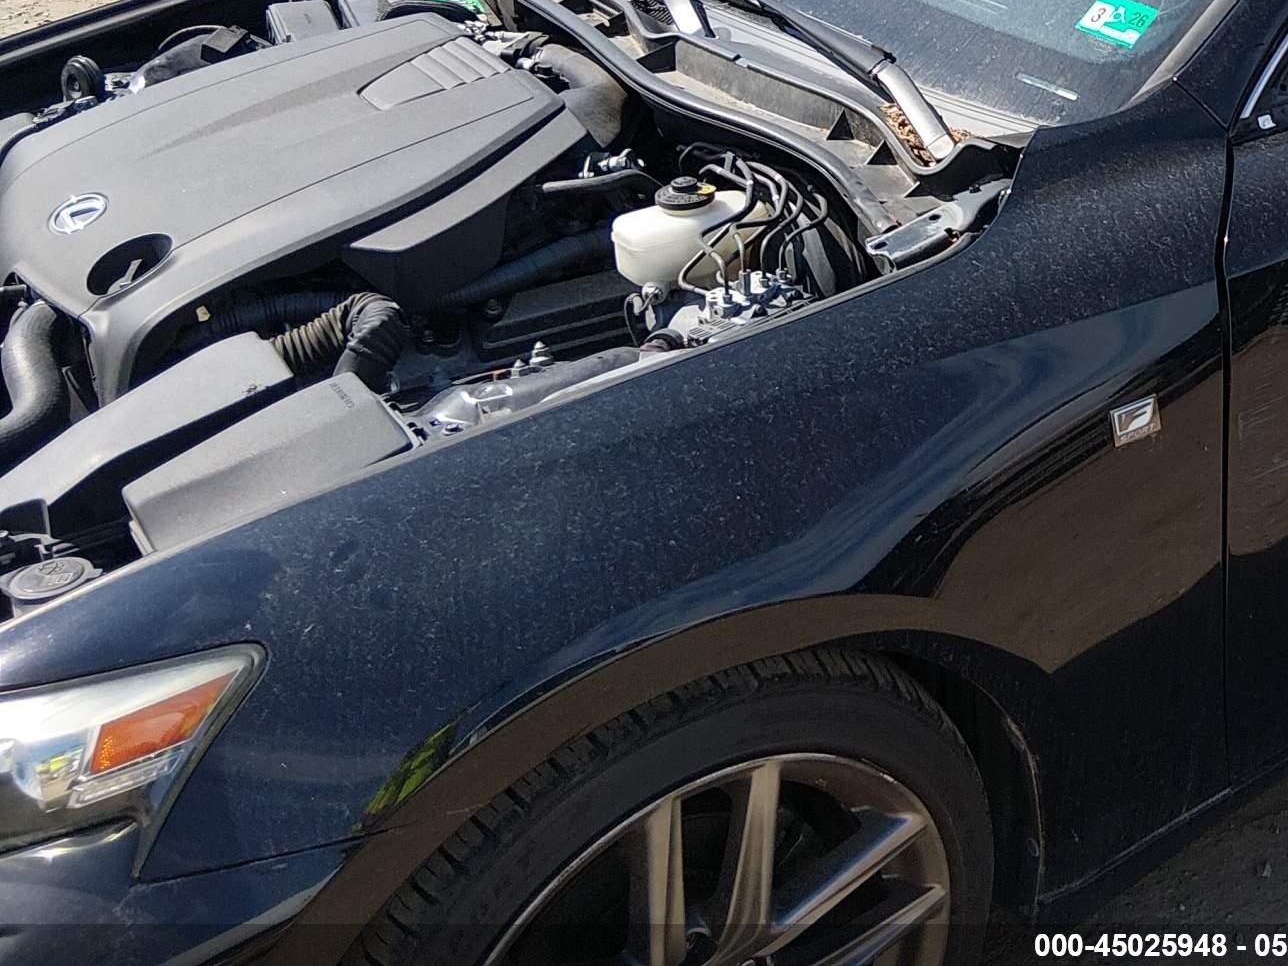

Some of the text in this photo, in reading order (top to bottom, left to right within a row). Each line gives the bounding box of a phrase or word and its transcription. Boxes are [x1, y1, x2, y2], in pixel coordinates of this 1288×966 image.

[1090, 7, 1150, 28] 3 26
[1119, 423, 1156, 441] SPORT
